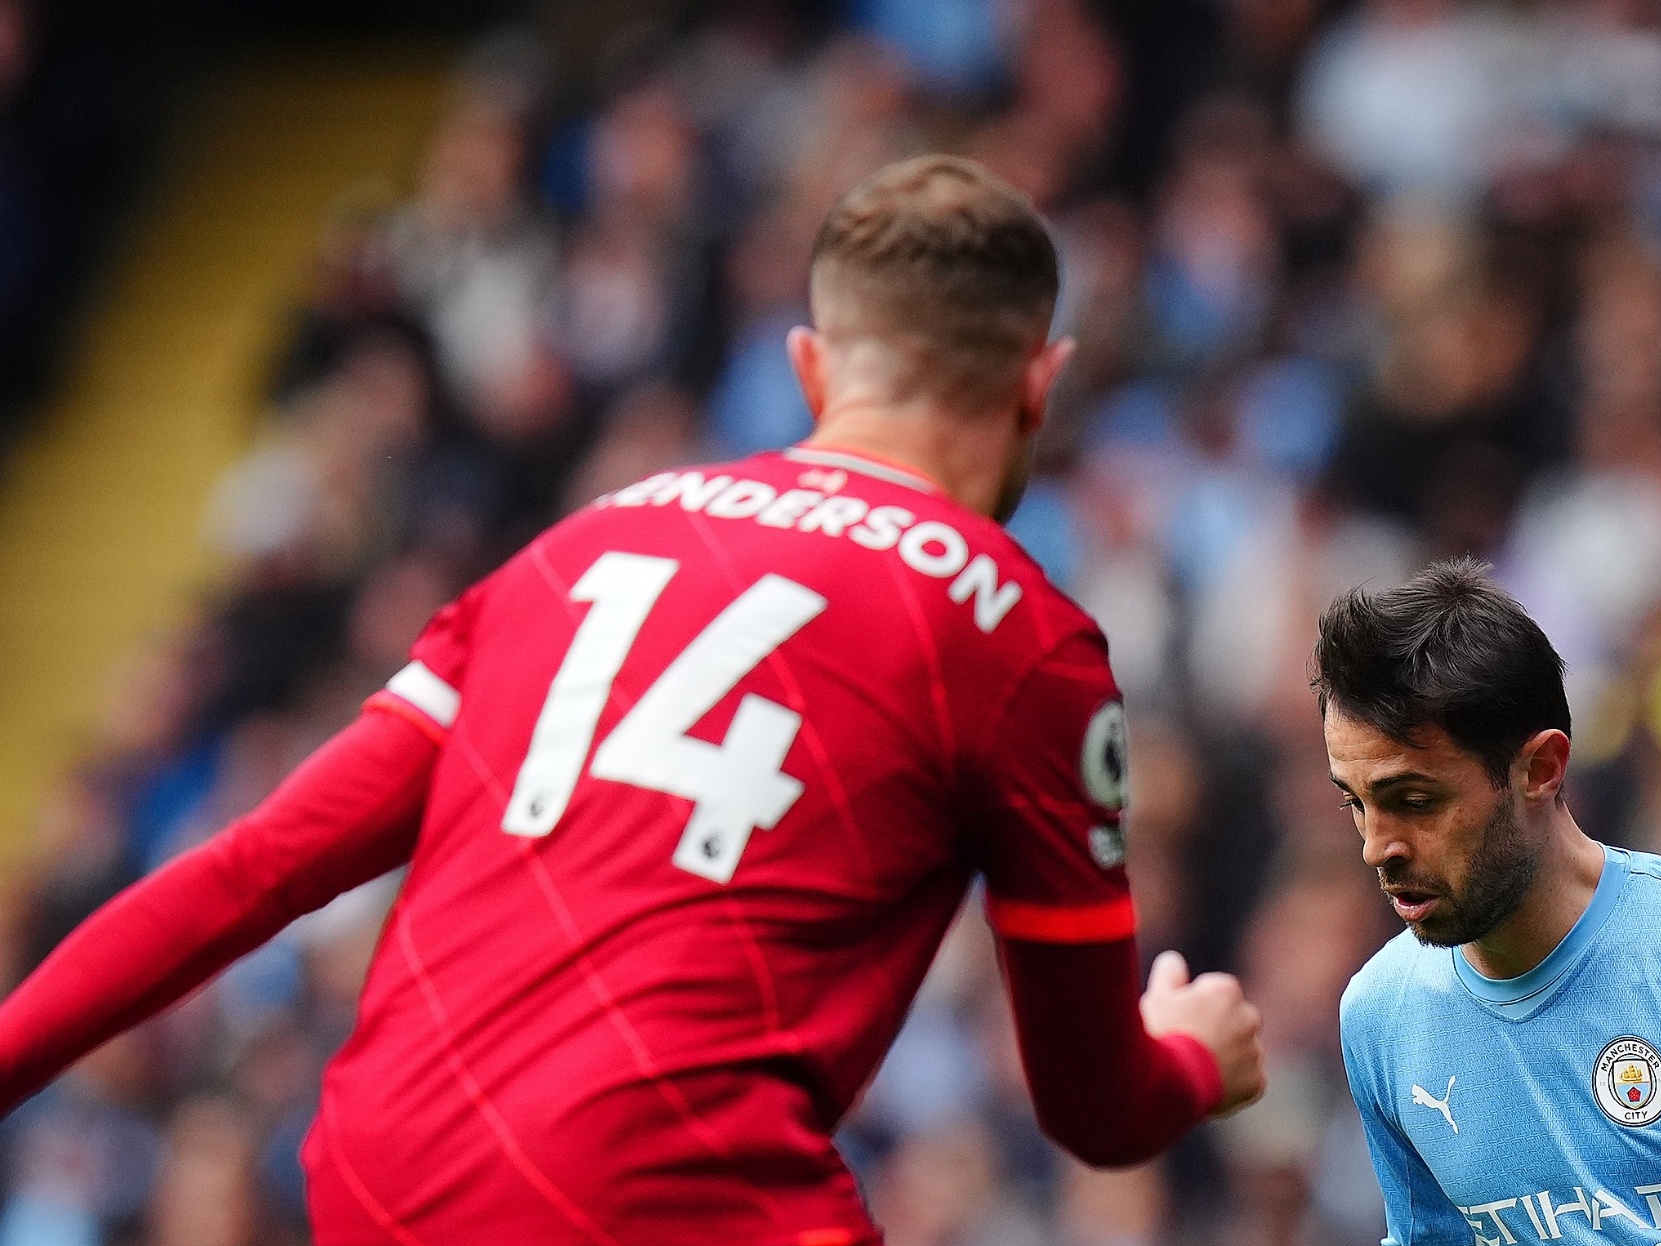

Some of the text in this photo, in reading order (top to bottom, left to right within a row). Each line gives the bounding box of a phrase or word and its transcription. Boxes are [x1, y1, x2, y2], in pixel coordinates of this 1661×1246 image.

[501, 550, 829, 884] 14
[1600, 1043, 1660, 1072] MANCHESTER
[1624, 1111, 1648, 1120] CITY
